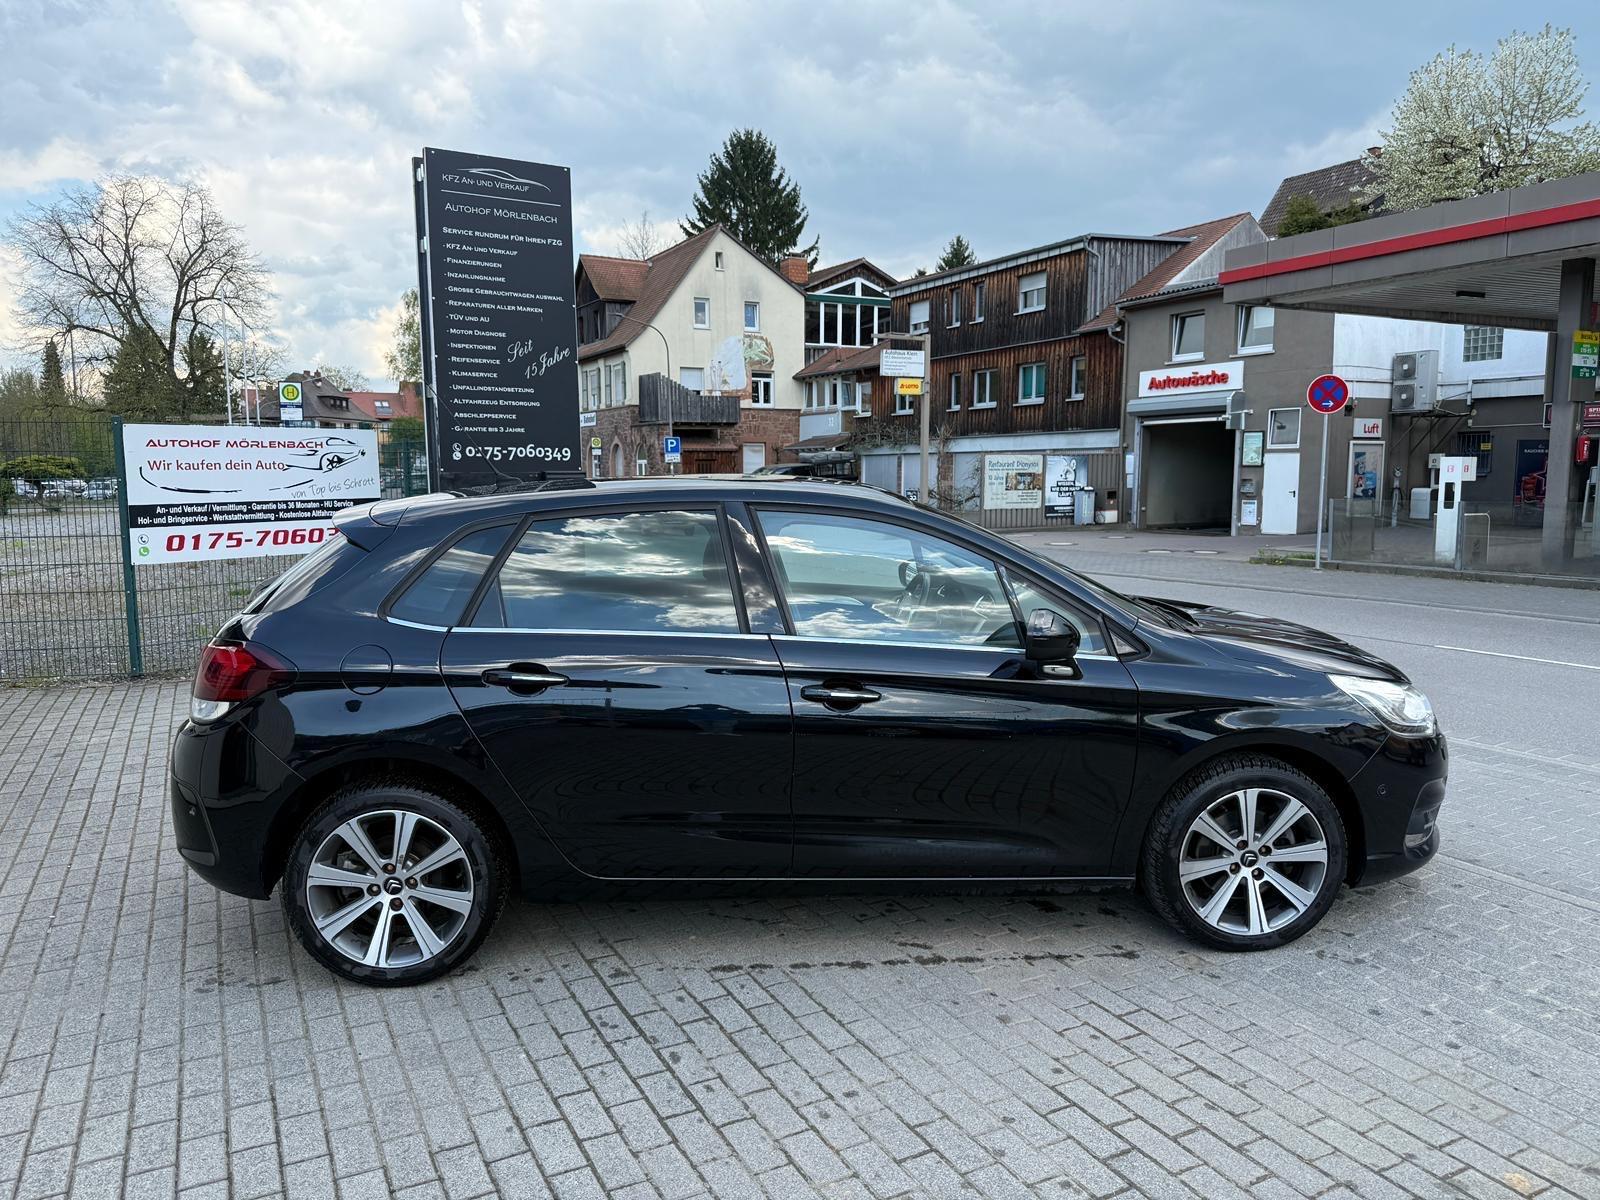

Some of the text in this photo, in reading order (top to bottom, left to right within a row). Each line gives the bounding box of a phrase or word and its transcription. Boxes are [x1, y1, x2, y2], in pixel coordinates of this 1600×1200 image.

[525, 346, 570, 379] 15 Jahre
[1148, 370, 1229, 390] Autowäsche
[287, 388, 294, 397] H
[1364, 423, 1379, 434] Luft
[146, 438, 323, 449] AUTOHOF MÖRLENBACH
[668, 439, 676, 451] P
[148, 460, 172, 470] Wir
[176, 460, 221, 470] kaufen
[225, 460, 252, 470] dein
[308, 484, 326, 496] Top
[329, 482, 341, 492] bis
[343, 478, 375, 489] Schrott
[156, 506, 168, 514] An-
[170, 505, 182, 513] und
[183, 504, 208, 513] Verkauf
[212, 504, 247, 512] Vermittlung
[252, 502, 276, 510] Garantie
[296, 501, 320, 509] Monaten
[138, 516, 152, 525] Hol-
[153, 516, 166, 524] und
[167, 514, 208, 524] Bringservice
[213, 512, 274, 521] Werkstattvermittlung
[279, 510, 311, 519] Kostenlose
